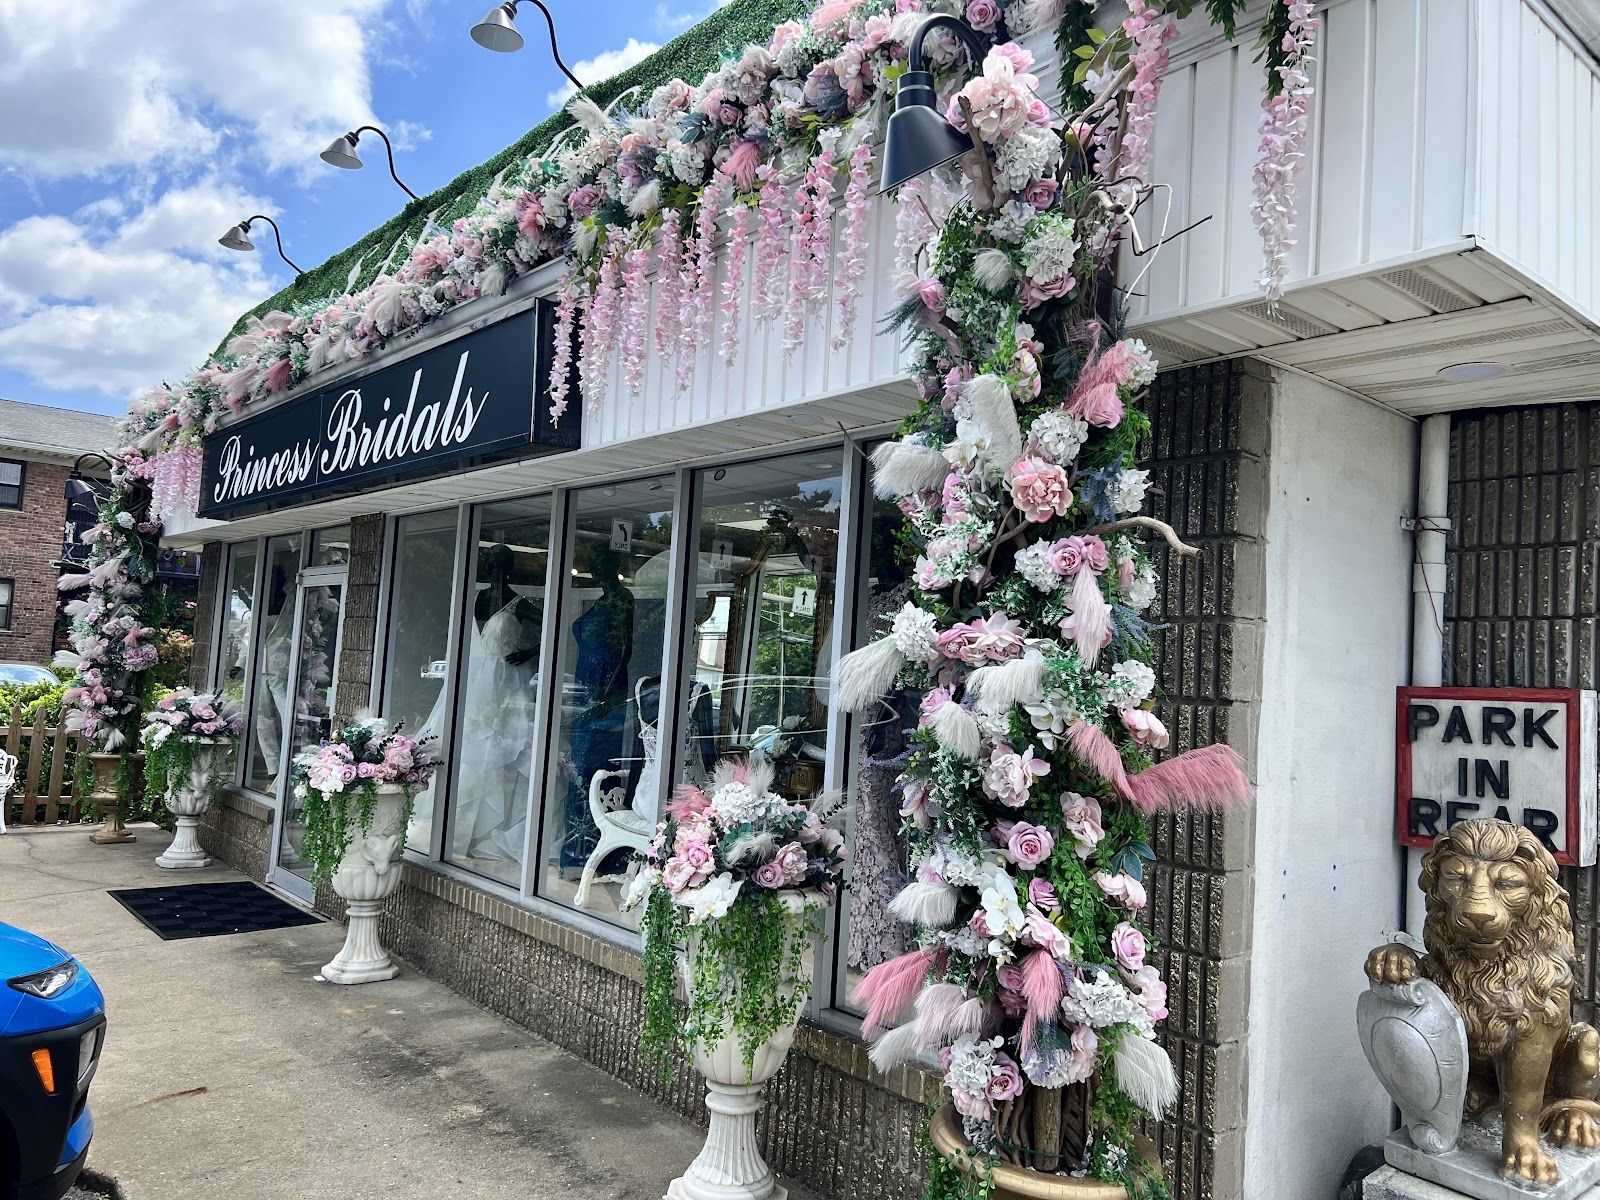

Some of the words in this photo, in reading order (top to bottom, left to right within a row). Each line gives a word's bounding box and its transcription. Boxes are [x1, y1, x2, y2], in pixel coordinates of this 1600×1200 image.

[214, 434, 320, 503] Princess
[321, 350, 490, 475] Bridals
[1407, 704, 1559, 750] PARK
[1458, 757, 1510, 800] IN
